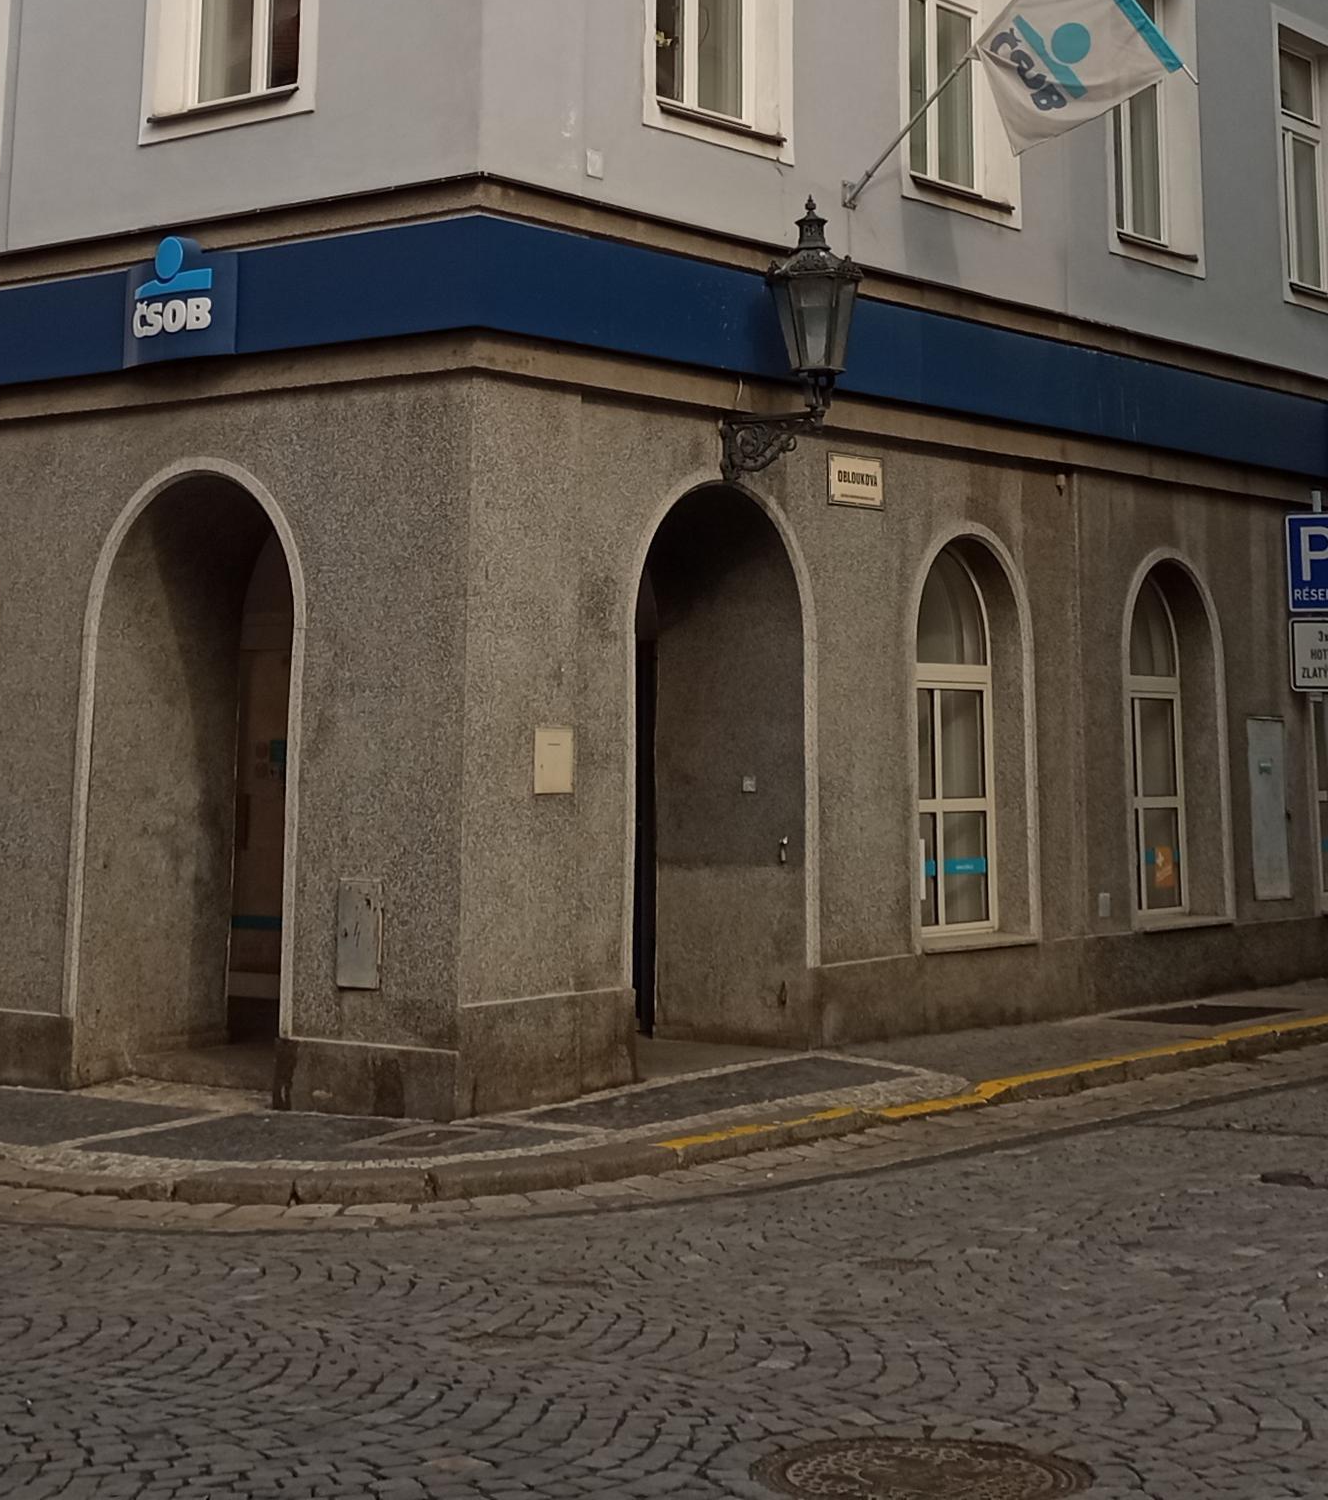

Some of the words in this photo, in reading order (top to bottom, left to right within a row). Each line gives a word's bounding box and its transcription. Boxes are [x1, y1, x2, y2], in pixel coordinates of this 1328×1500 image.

[132, 297, 212, 338] ČSOB
[837, 470, 878, 487] OBLOUKOVÁ
[1317, 630, 1328, 642] 3x
[1301, 664, 1328, 679] ZLATÝ
